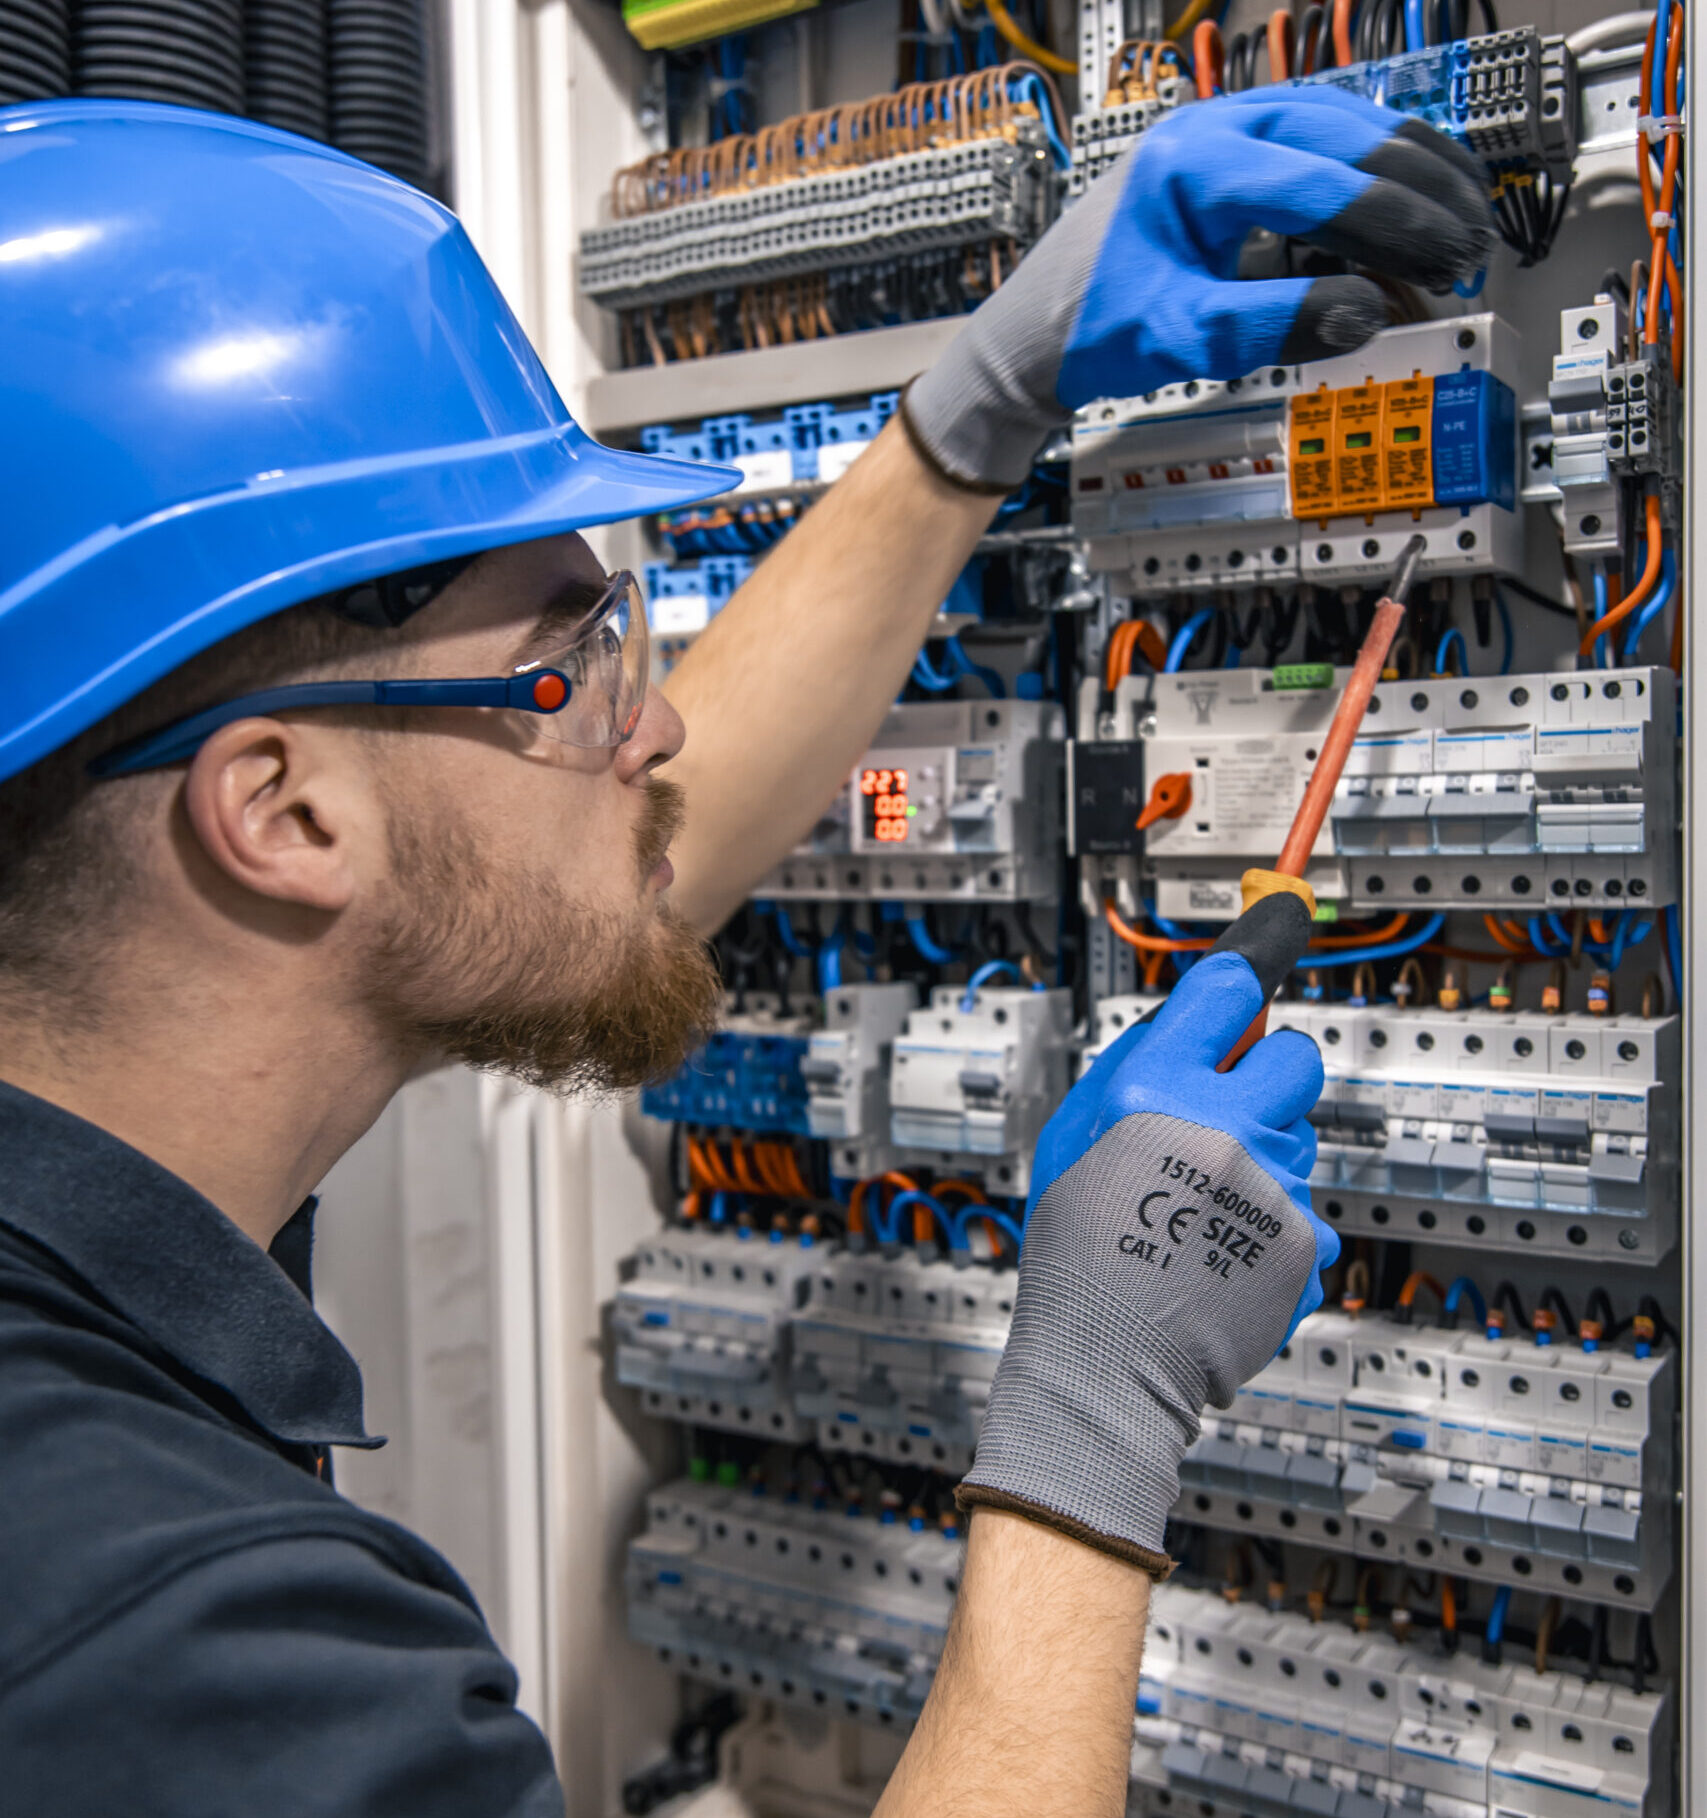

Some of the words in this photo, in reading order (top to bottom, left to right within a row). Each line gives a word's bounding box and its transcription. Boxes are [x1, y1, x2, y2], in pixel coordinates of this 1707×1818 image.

[1442, 420, 1467, 433] N-PE
[860, 769, 909, 795] 227
[1161, 1155, 1283, 1239] 1512-600009
[1138, 1191, 1199, 1244] CE
[1119, 1234, 1158, 1263] CAT.
[1202, 1216, 1265, 1268] SIZE
[1203, 1250, 1231, 1279] 9/L
